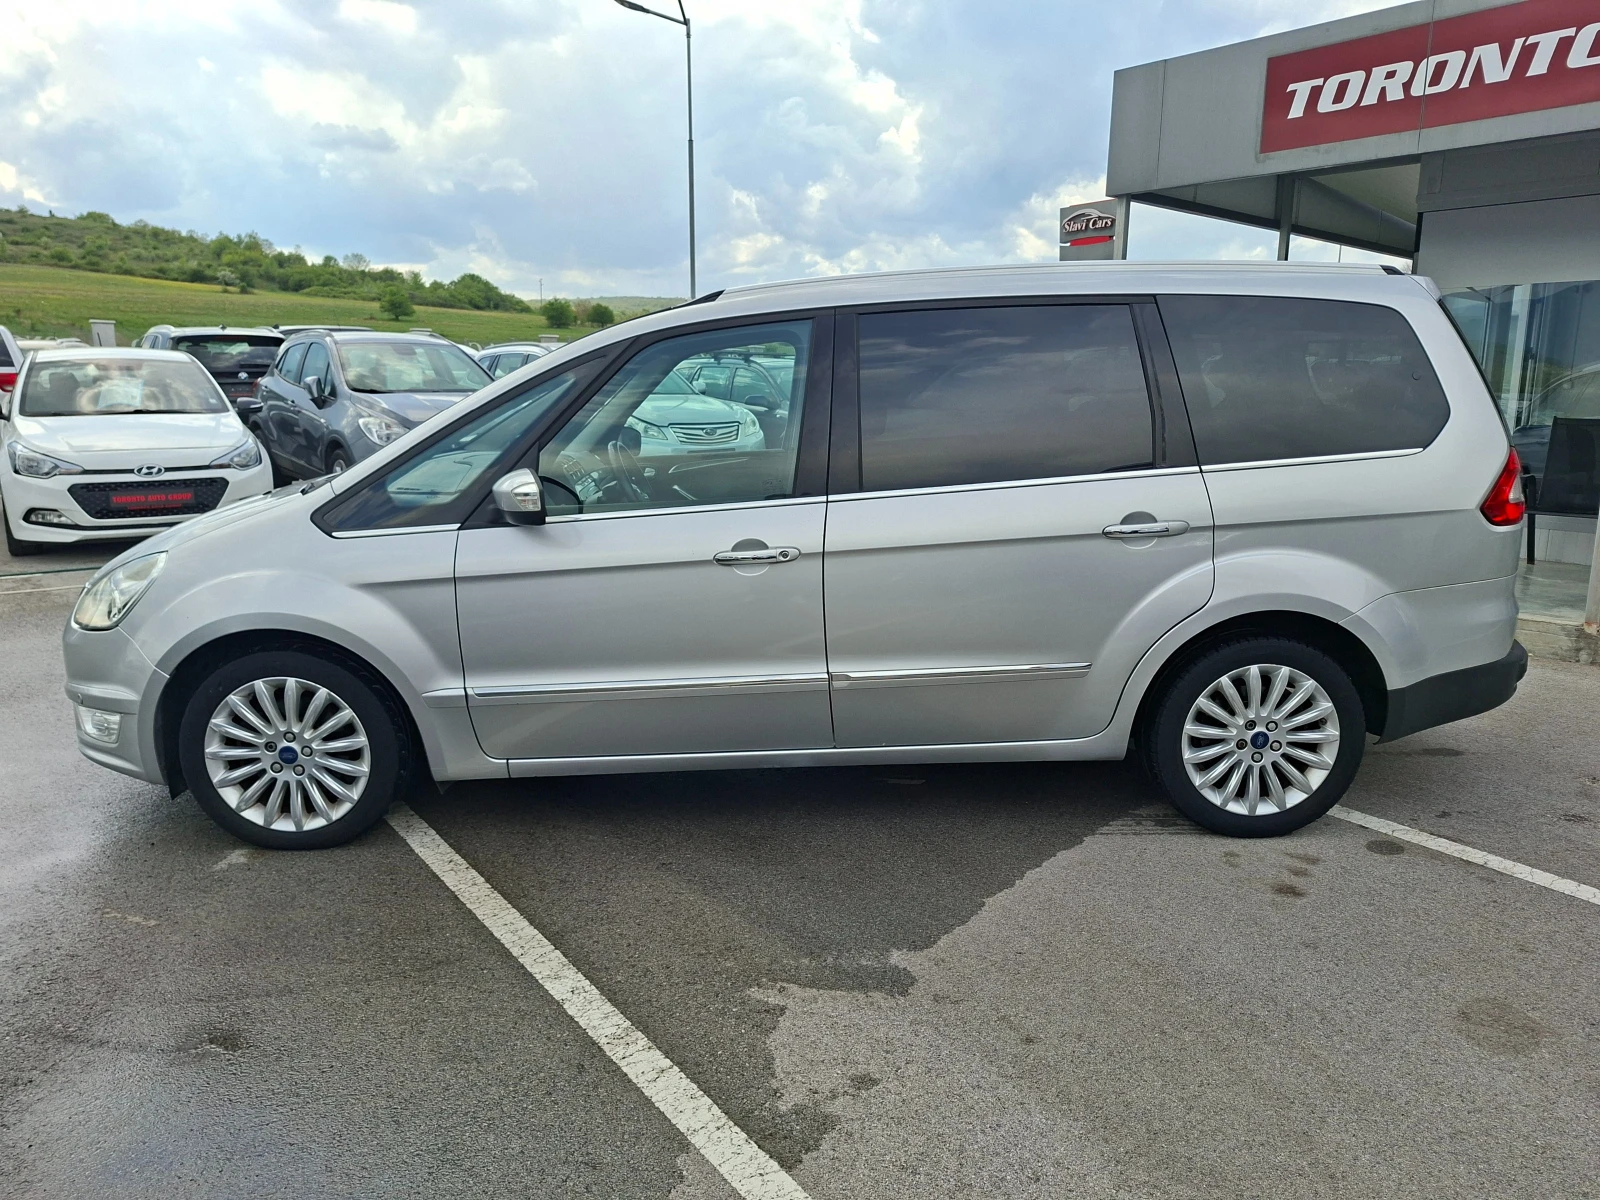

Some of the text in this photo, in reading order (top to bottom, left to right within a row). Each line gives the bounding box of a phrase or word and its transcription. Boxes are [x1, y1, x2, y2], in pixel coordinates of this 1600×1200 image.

[1063, 217, 1112, 233] Slavi Cars
[112, 492, 192, 503] TORONTO AUTO GROUP
